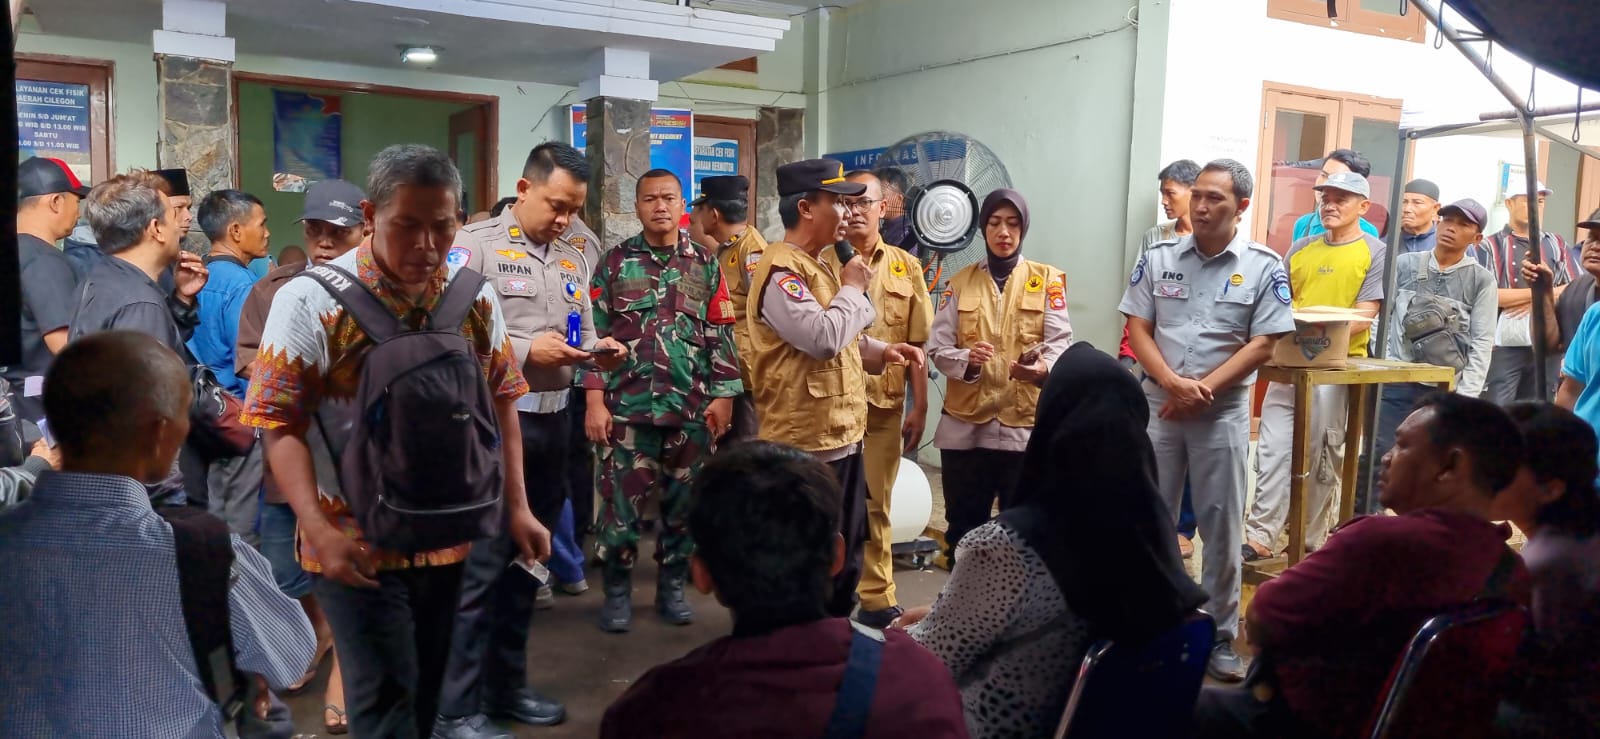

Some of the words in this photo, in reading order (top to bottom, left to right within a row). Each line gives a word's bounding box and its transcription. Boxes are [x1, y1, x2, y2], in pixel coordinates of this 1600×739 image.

[49, 87, 65, 95] CEK
[66, 89, 85, 97] FISIK
[44, 96, 76, 105] CILEGON
[34, 131, 58, 139] SABTU
[497, 262, 532, 276] IRPAN
[560, 271, 584, 285] POLRI
[1162, 270, 1184, 281] ENO
